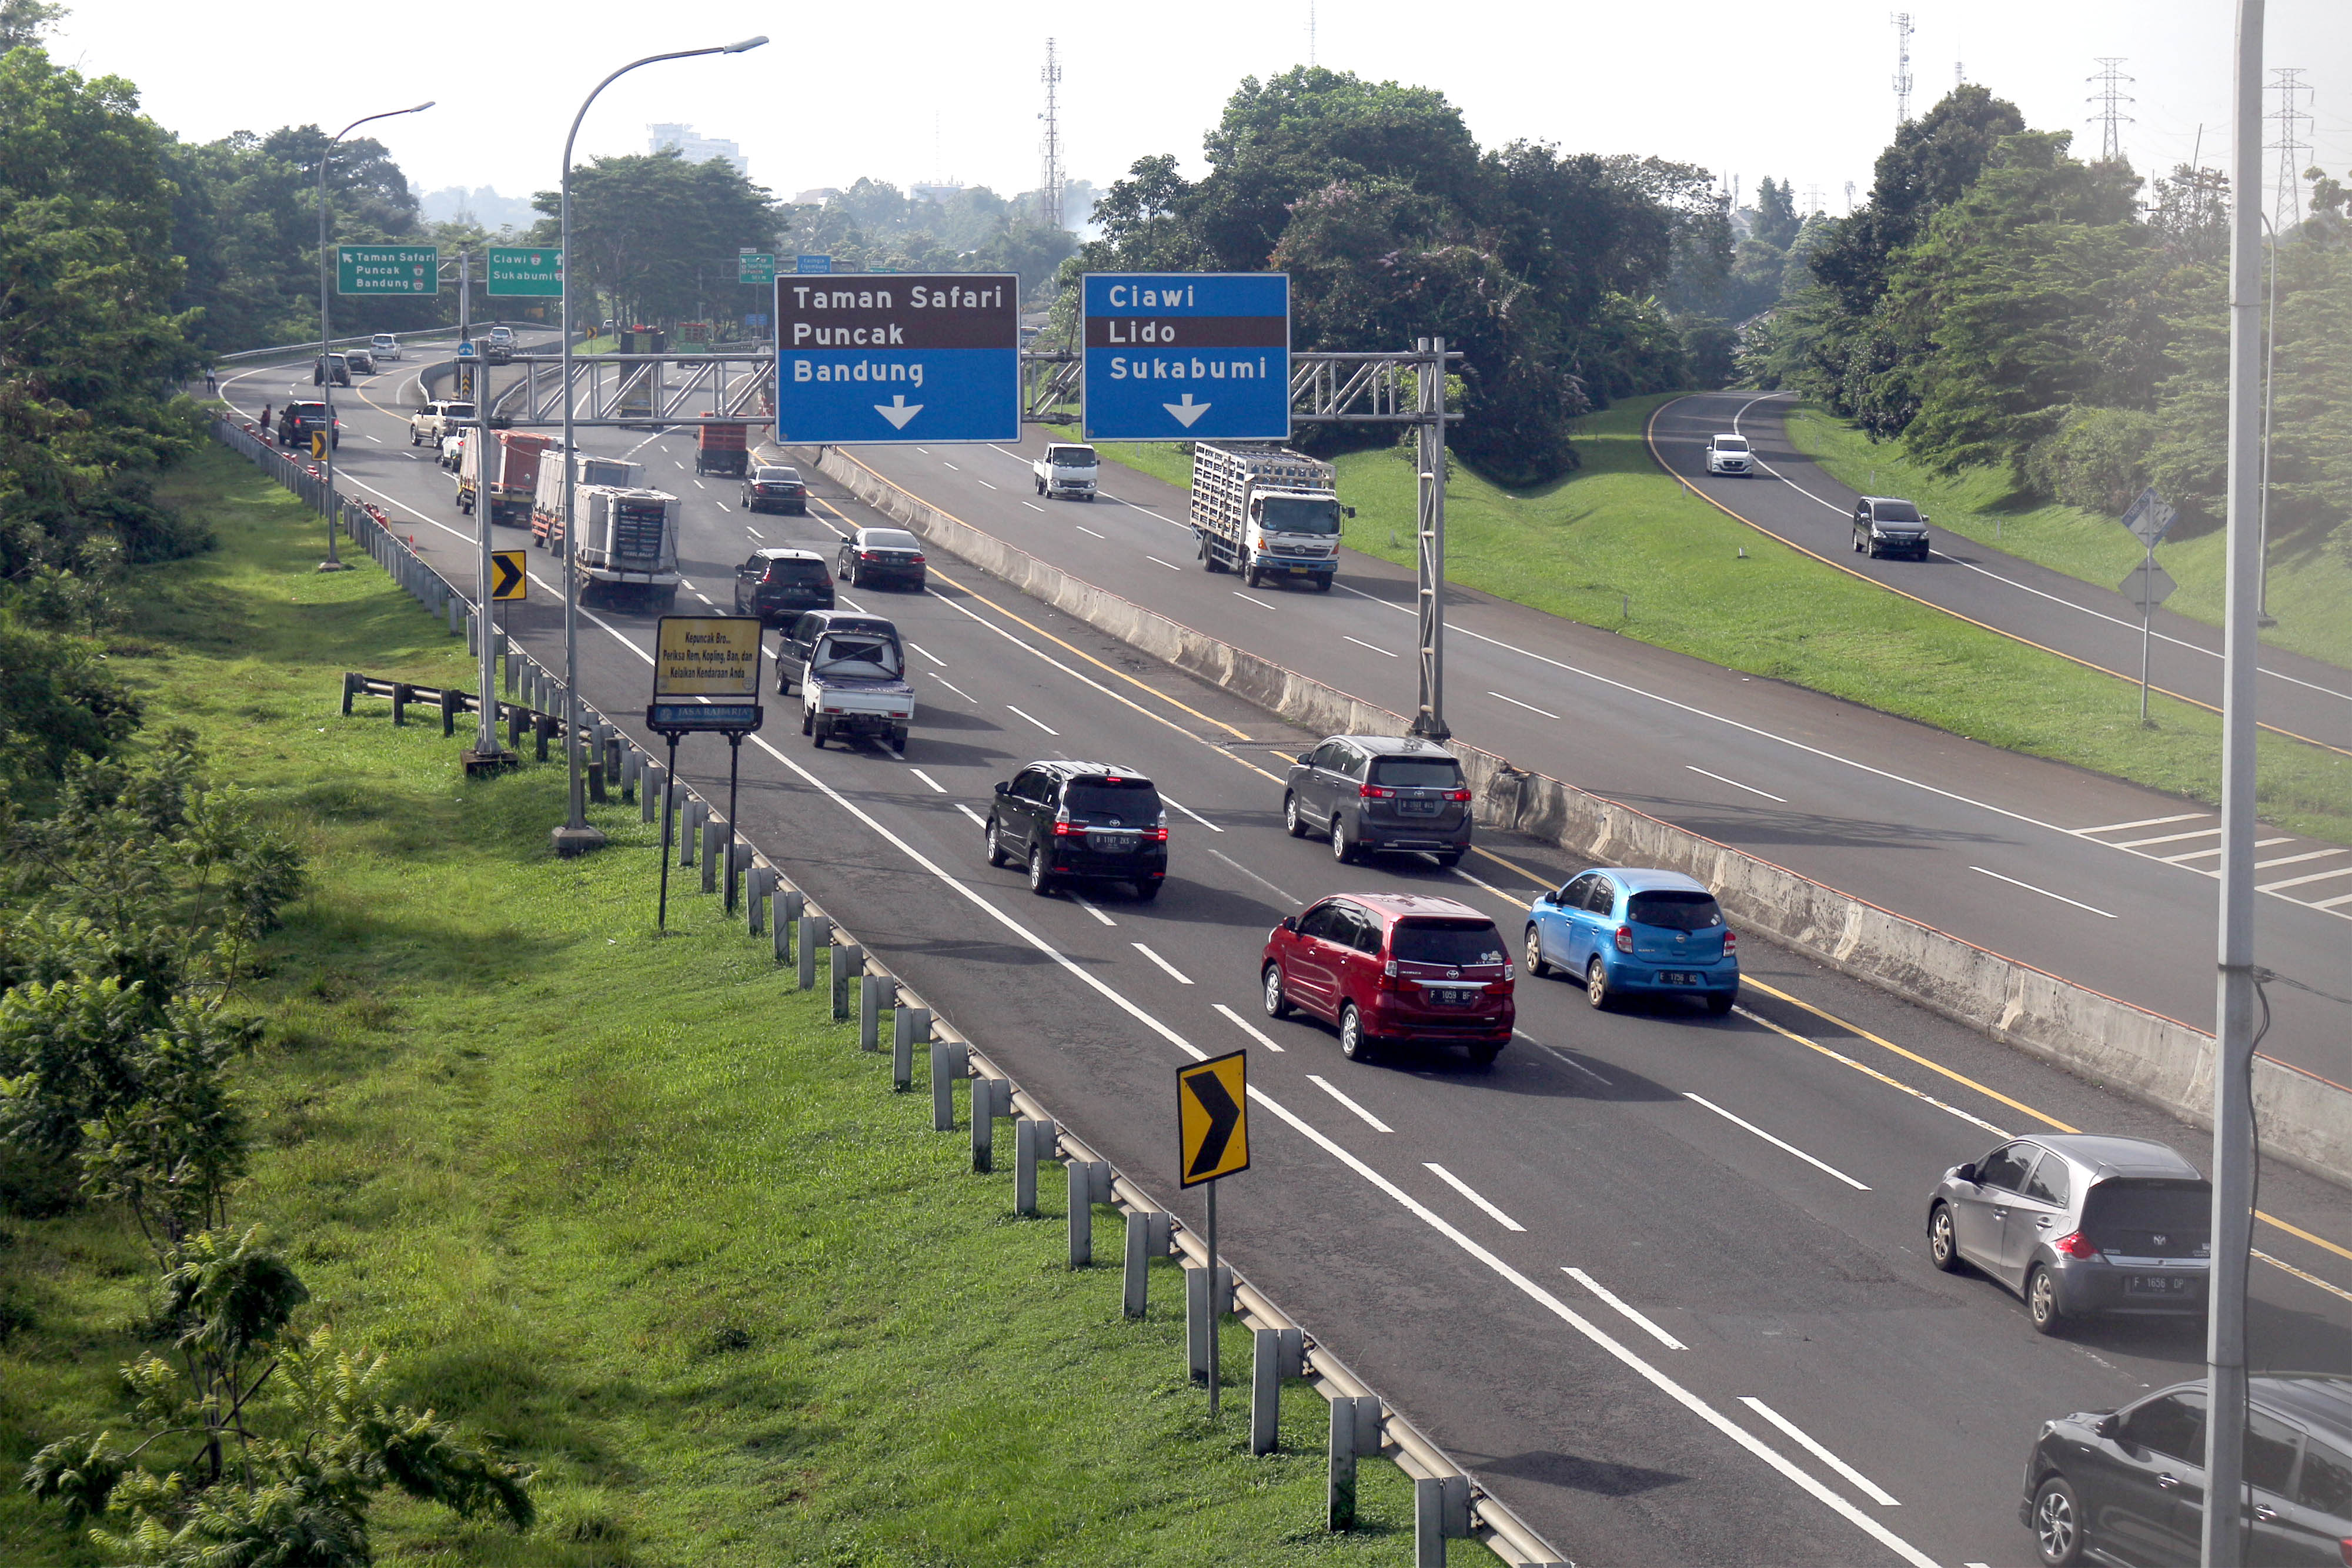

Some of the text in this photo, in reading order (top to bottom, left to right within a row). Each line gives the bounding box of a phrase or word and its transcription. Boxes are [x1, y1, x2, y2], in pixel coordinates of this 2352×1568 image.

[356, 252, 435, 262] Taman Safari
[493, 254, 526, 263] Ciawi
[356, 266, 400, 275] Puncak
[493, 271, 552, 280] Sukabumi
[356, 279, 409, 290] Bandung
[793, 286, 1001, 309] Taman Safari
[1110, 285, 1194, 307] Ciawi
[794, 323, 904, 345] Puncak
[1110, 321, 1175, 343] Lido
[794, 360, 923, 388] Bandung
[1110, 357, 1267, 379] Sukabumi
[686, 631, 714, 645] Kepuncak
[663, 649, 685, 661] Periksa
[687, 650, 700, 663] Rem,
[727, 650, 740, 663] Ban,
[741, 650, 753, 661] dan
[697, 667, 728, 678] Kendaraan
[730, 668, 745, 678] Anda
[1431, 990, 1471, 1000] F 1059 BF
[2134, 1276, 2140, 1287] F
[2147, 1278, 2166, 1289] 1656
